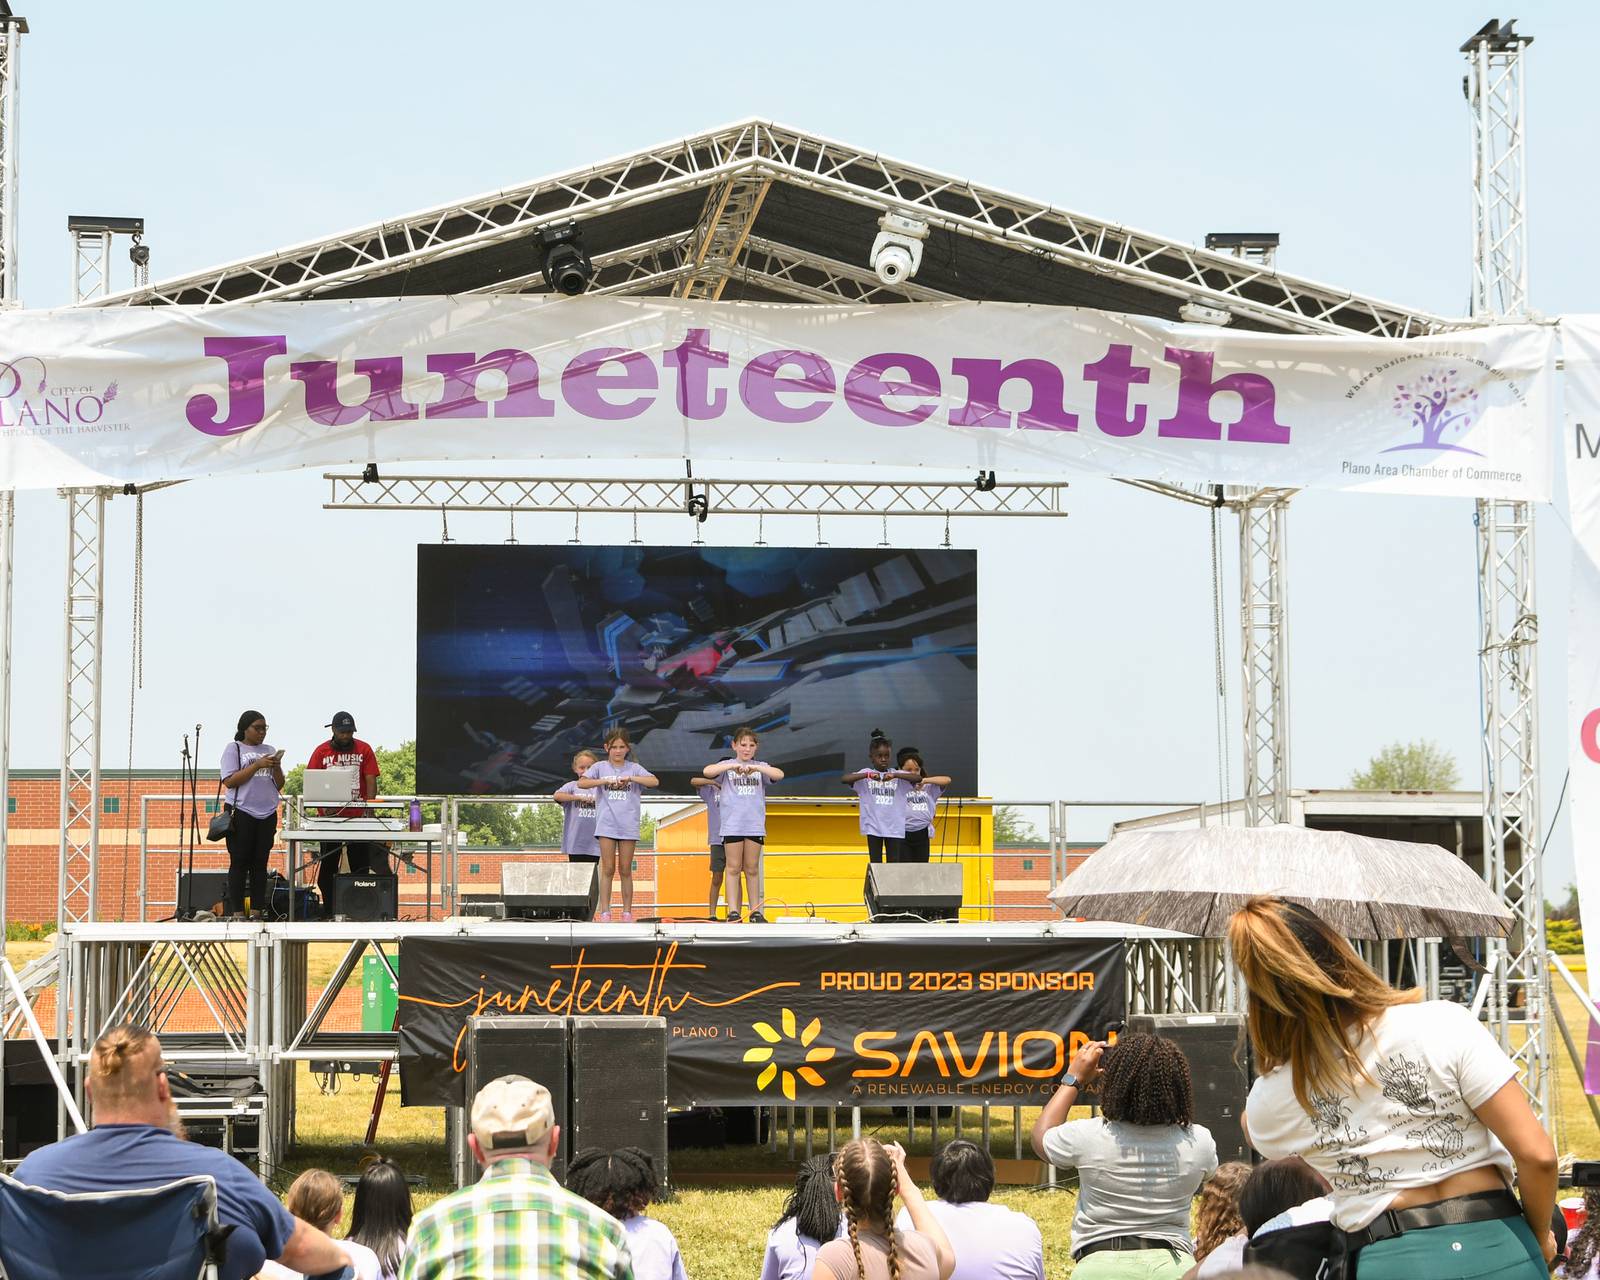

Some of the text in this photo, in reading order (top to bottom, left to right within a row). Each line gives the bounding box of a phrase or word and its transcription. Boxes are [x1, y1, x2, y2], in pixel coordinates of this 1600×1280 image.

[1345, 373, 1373, 398] Where
[1376, 353, 1424, 373] business
[51, 386, 94, 396] CITY OF
[186, 328, 1291, 444] Juneteenth
[40, 427, 51, 435] OF
[56, 426, 72, 434] THE
[78, 423, 131, 433] HARVESTER
[1342, 461, 1522, 482] Plano Area Chamber of Commerce
[322, 755, 335, 765] MY
[338, 753, 363, 763] MUSIC
[608, 791, 627, 800] 2023
[579, 808, 596, 818] 2023
[820, 972, 1095, 991] PROUD 2023 SPONSOR
[672, 1026, 736, 1038] PLANO IL
[852, 1083, 1105, 1095] A RENEWABLE ENERGY COAN
